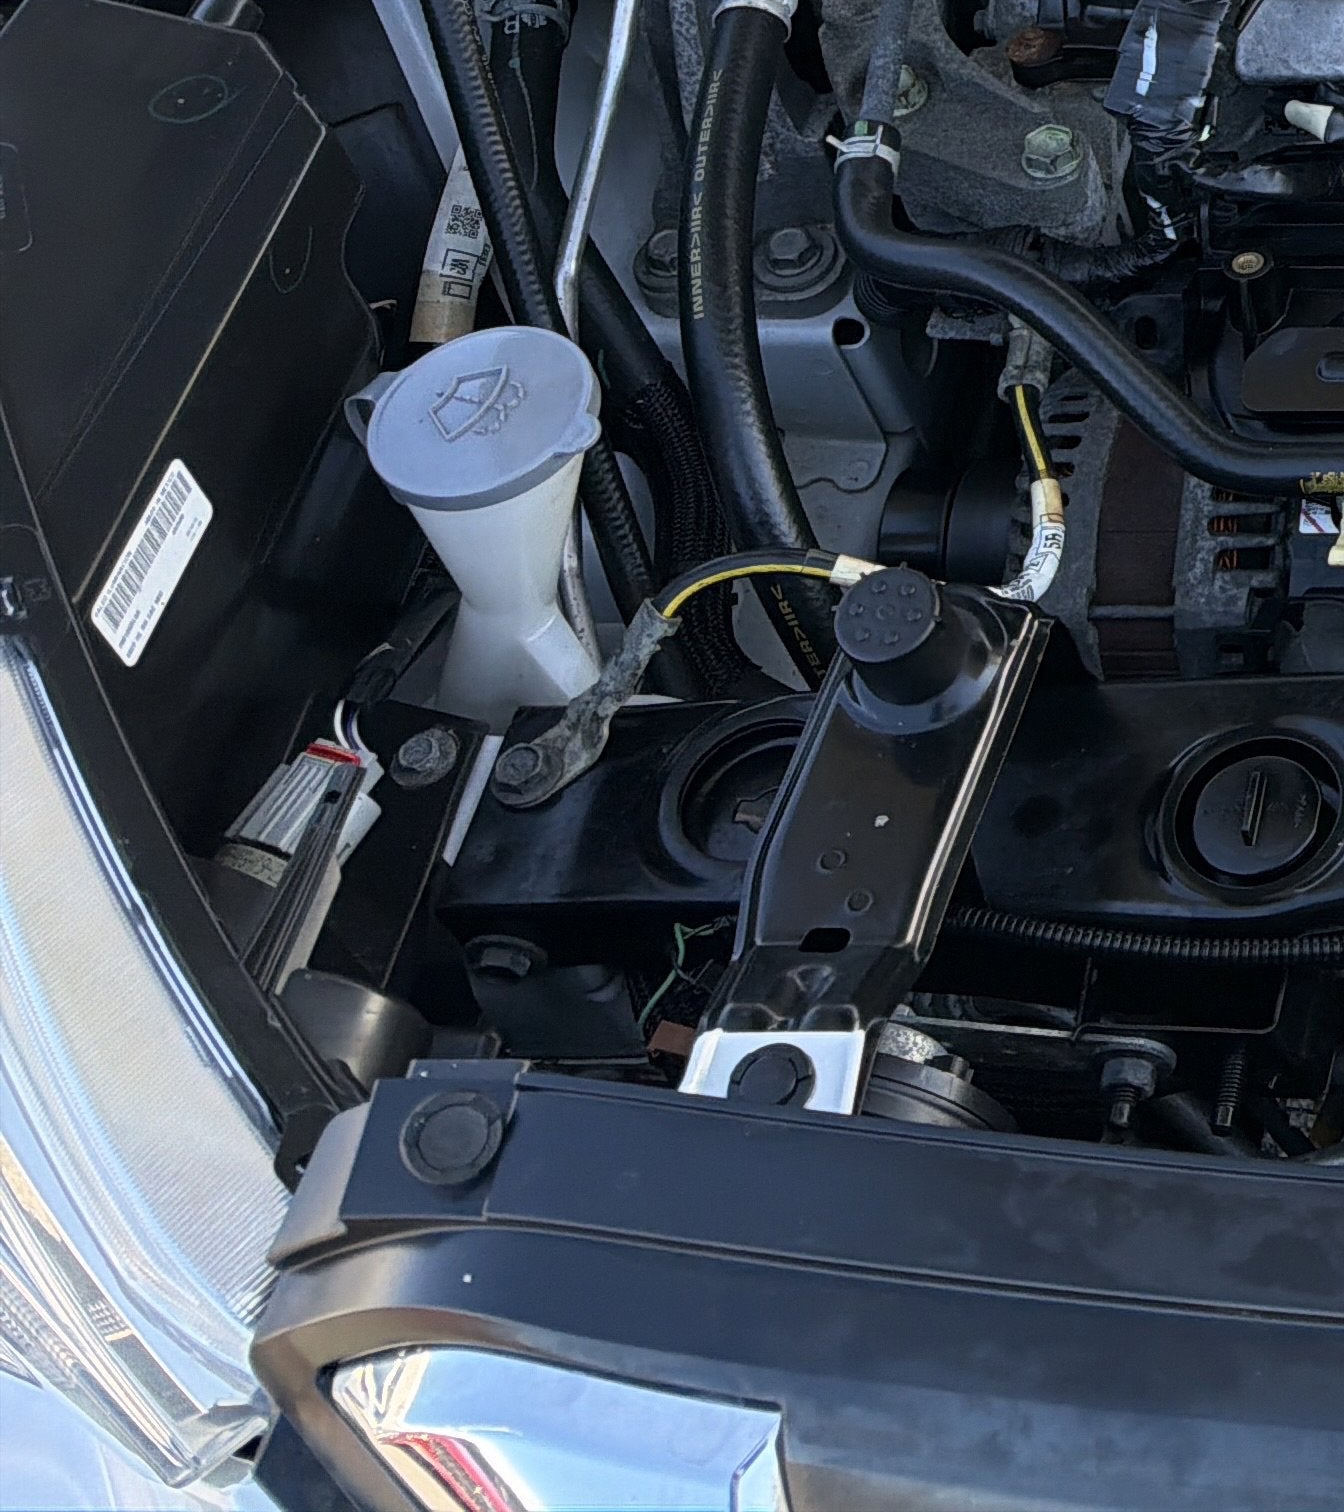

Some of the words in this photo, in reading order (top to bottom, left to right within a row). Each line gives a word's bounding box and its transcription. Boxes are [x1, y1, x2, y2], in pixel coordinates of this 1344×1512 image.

[694, 67, 722, 181] OUTER>IIR<
[690, 190, 706, 320] INNER>IIR<
[1041, 530, 1063, 550] 5A
